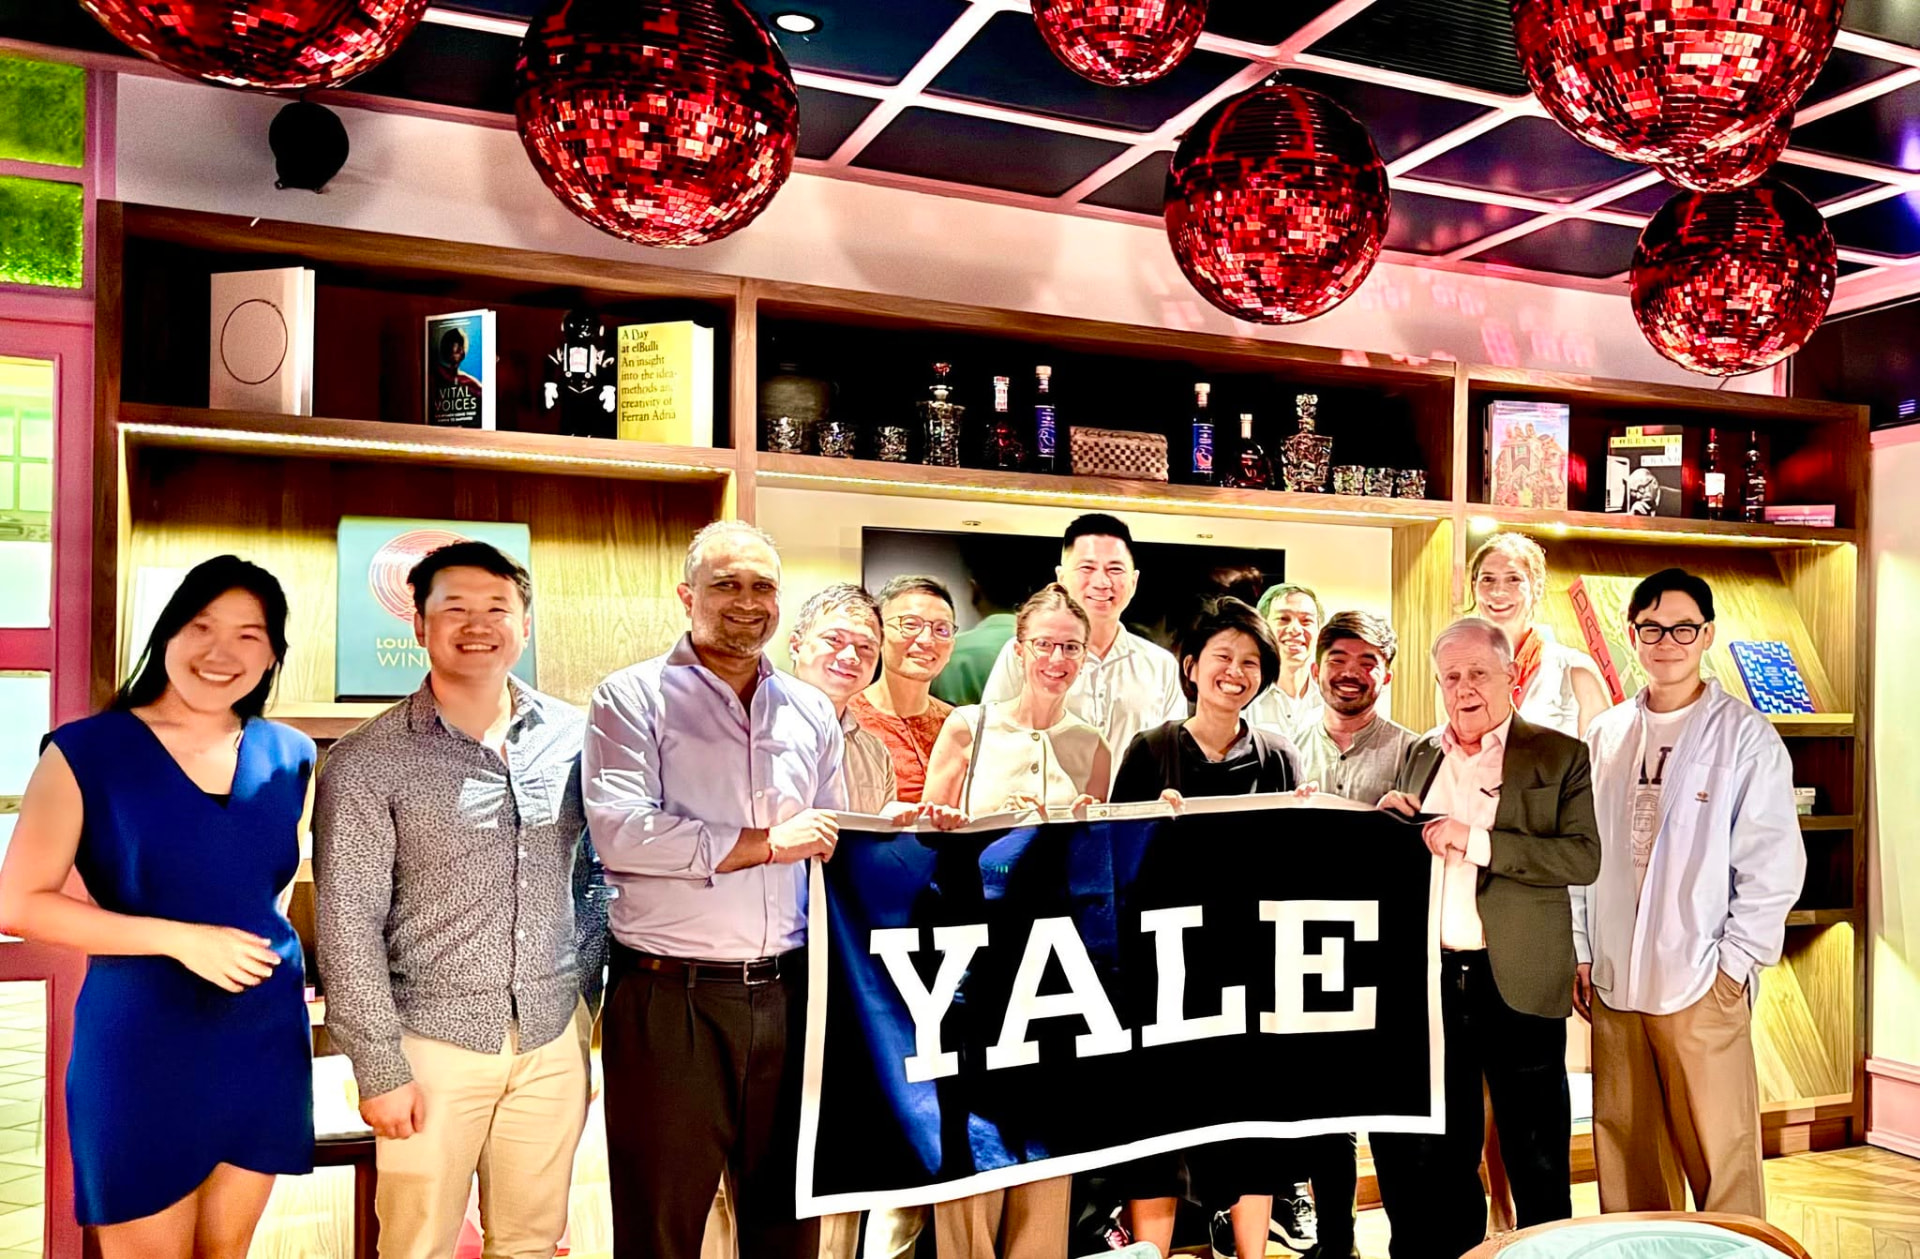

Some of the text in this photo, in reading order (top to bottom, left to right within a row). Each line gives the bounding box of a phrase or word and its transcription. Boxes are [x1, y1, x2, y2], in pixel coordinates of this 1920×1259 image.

[622, 328, 648, 341] A Day
[621, 344, 630, 353] at
[621, 354, 664, 367] An insight
[622, 371, 639, 381] into
[641, 369, 655, 381] the
[440, 385, 471, 399] VITAL
[621, 383, 658, 395] methods
[435, 397, 477, 411] VOICES
[621, 398, 660, 409] creativity
[621, 410, 650, 422] Ferran
[376, 651, 431, 667] WIN
[870, 900, 1379, 1083] YALE
